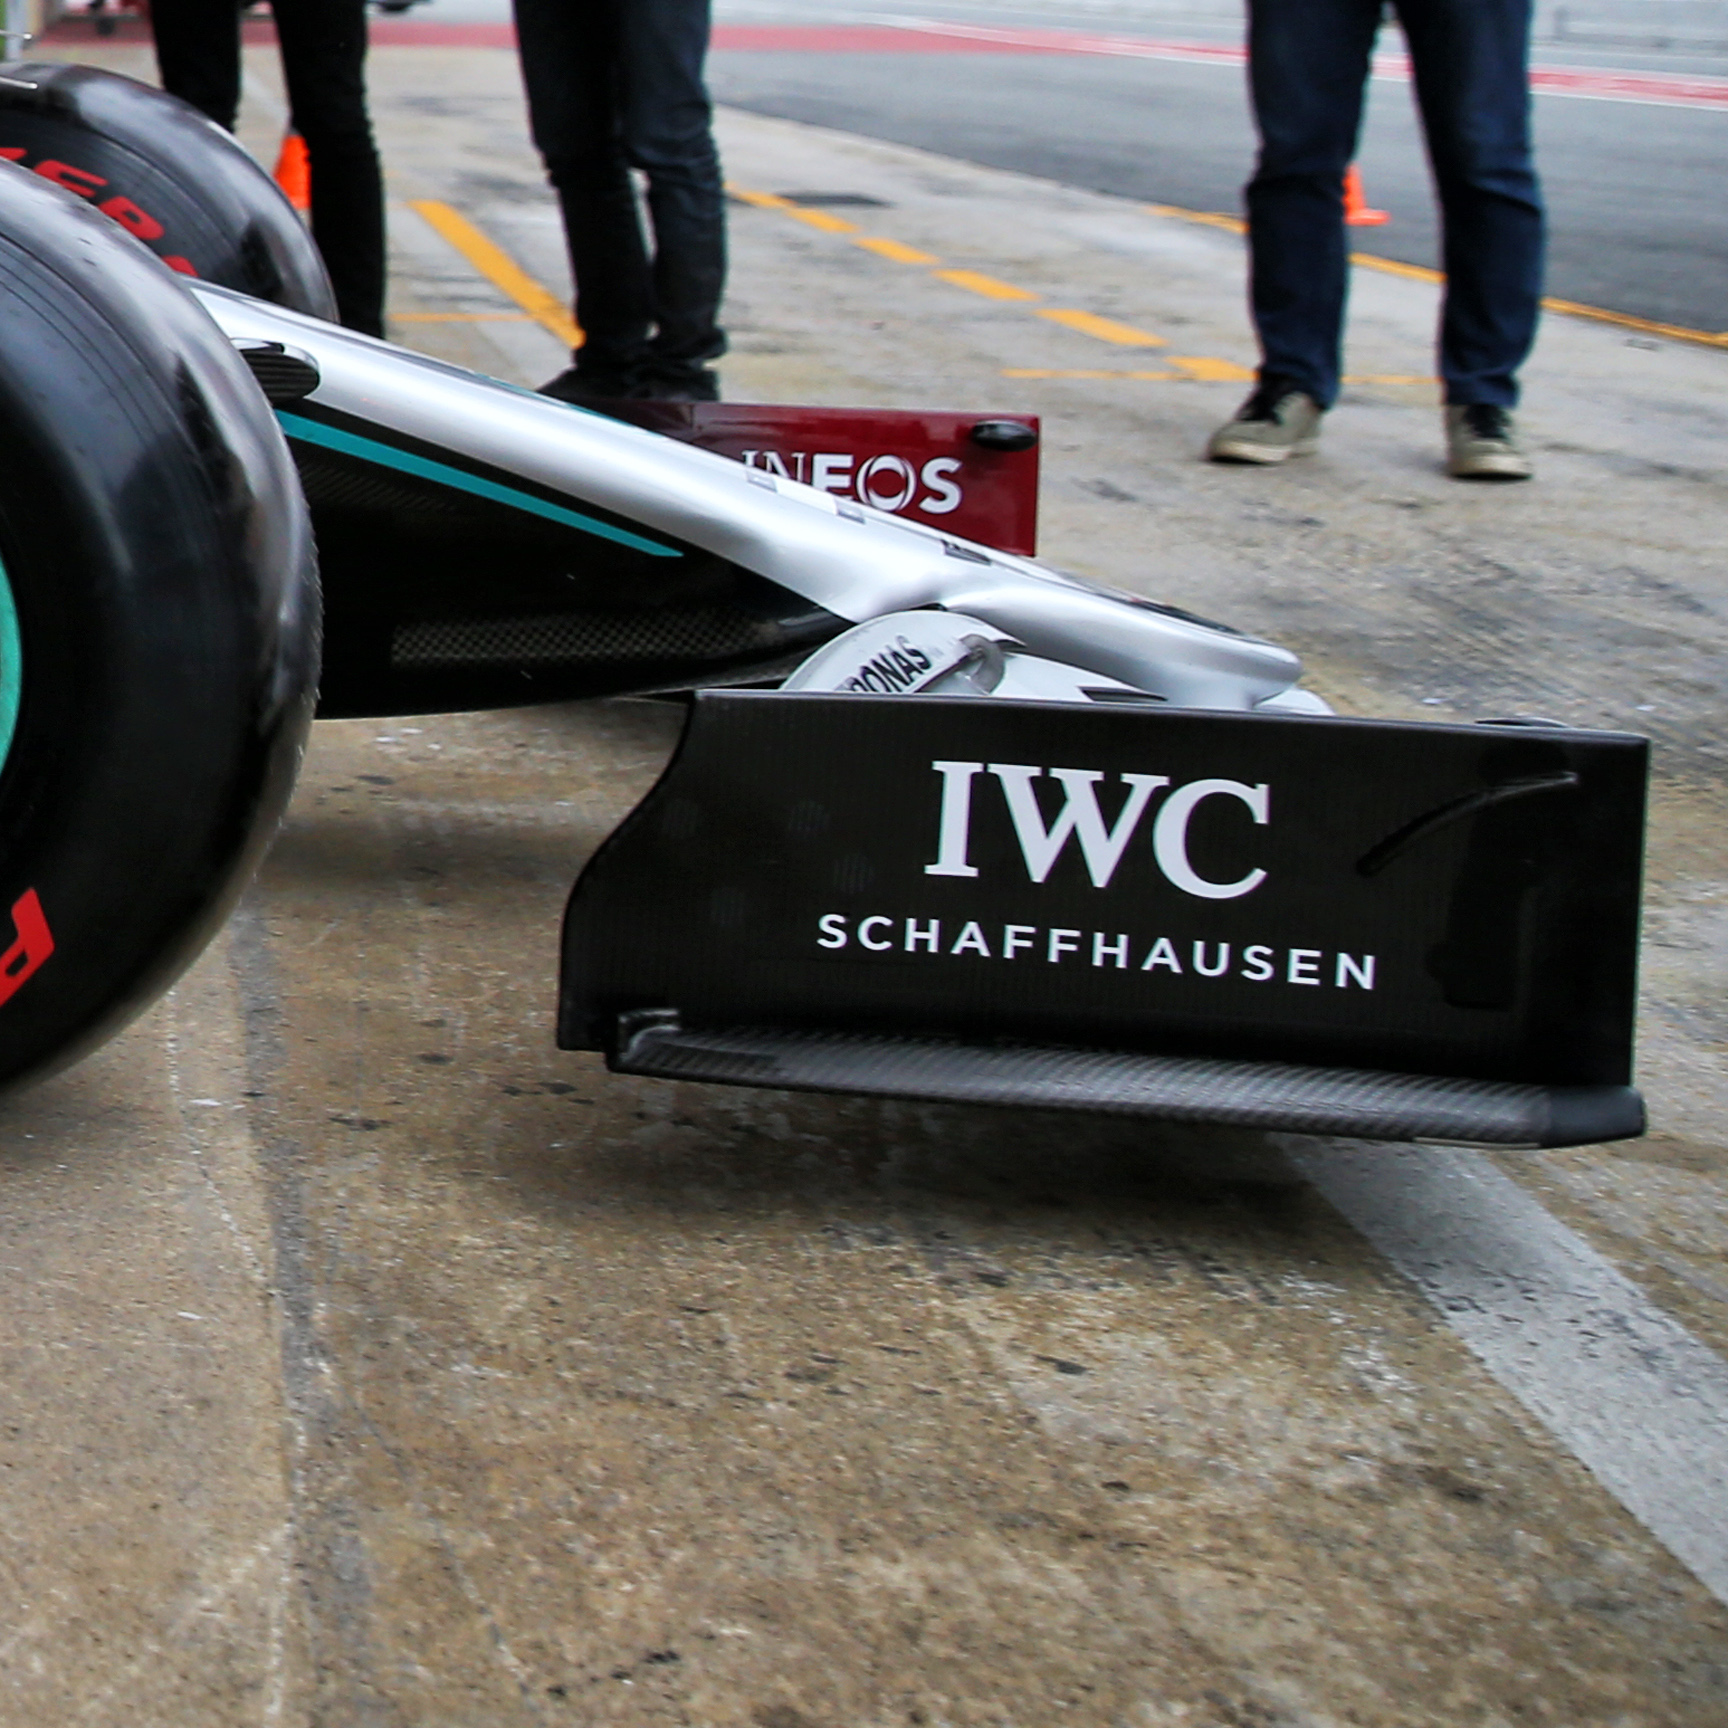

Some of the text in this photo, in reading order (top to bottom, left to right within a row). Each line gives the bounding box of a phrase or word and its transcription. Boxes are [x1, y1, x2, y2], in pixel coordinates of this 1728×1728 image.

[741, 450, 963, 515] EOS
[924, 760, 1270, 900] IWC
[816, 913, 1377, 991] SCHAFFHAUSEN
